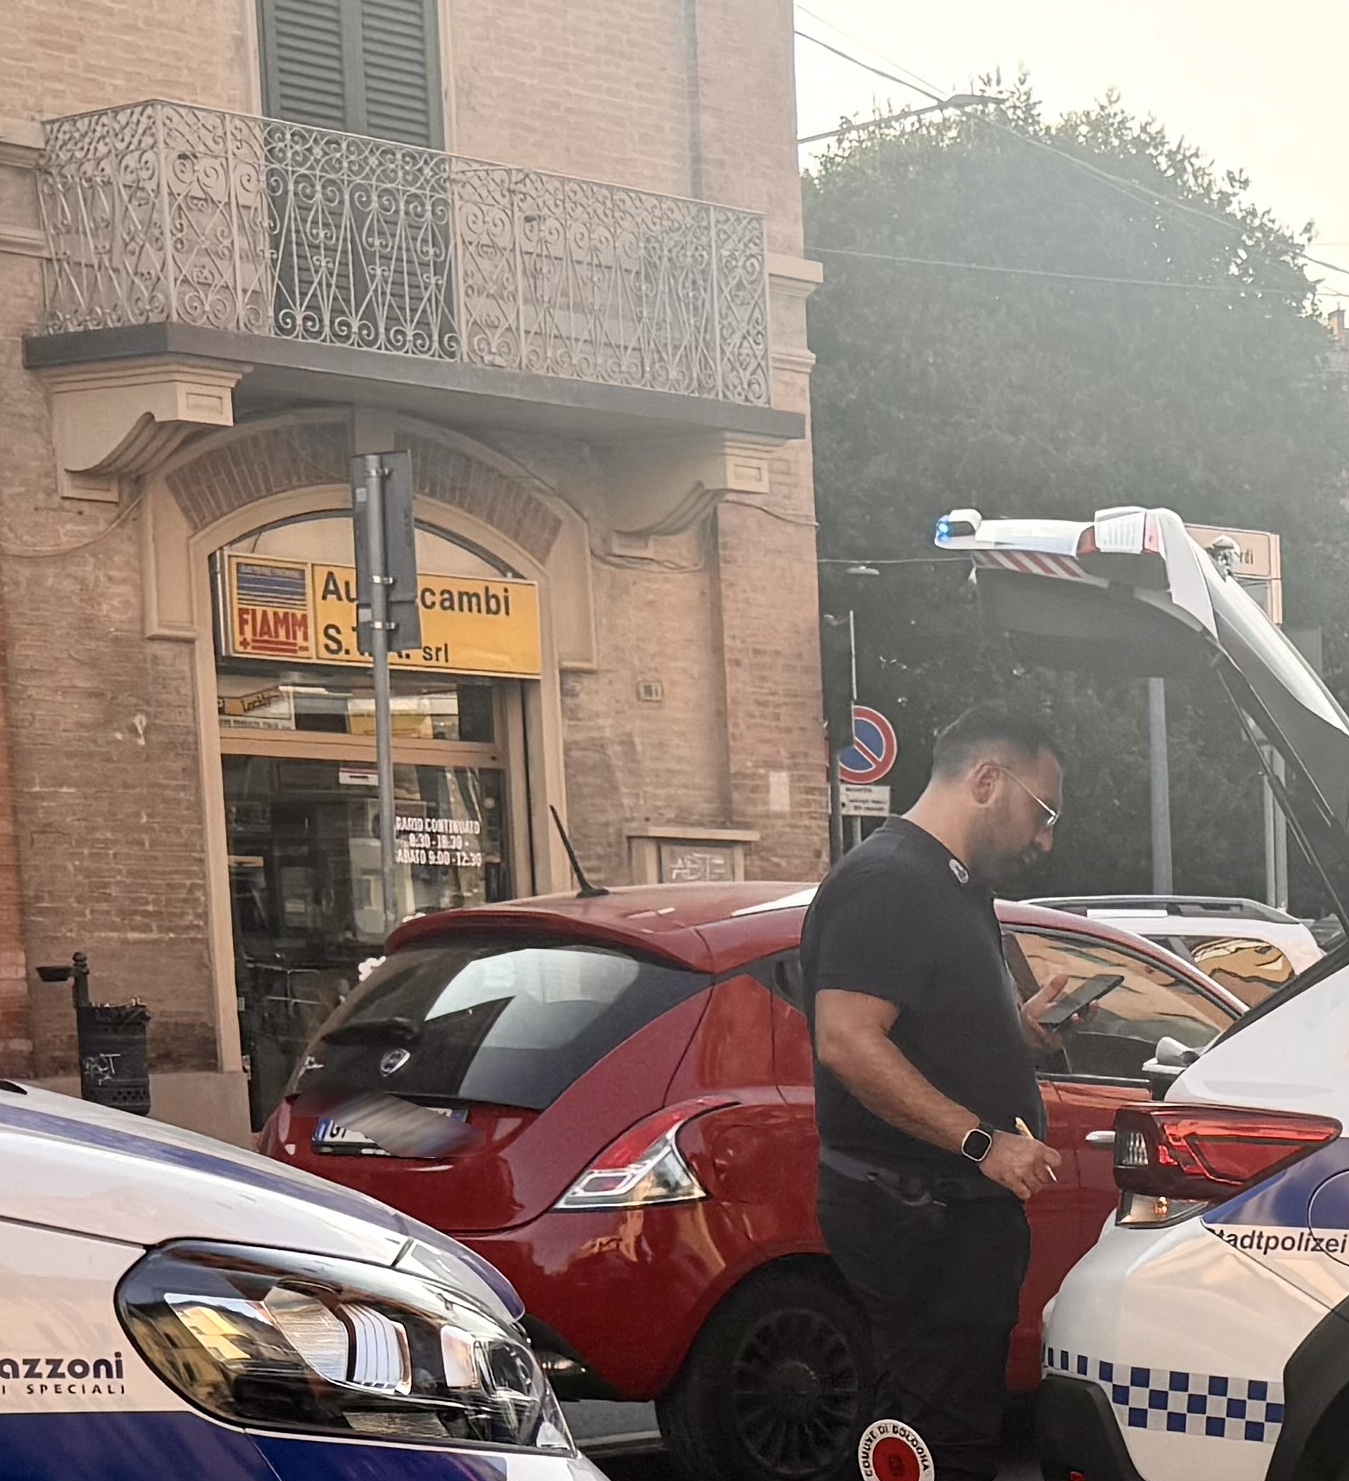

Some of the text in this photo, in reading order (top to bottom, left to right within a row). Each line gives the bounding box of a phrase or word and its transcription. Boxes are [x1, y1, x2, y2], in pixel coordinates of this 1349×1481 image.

[321, 571, 510, 616] Aucambi
[238, 607, 309, 641] FIAMM
[422, 642, 450, 662] srl
[395, 816, 480, 834] RARIO CONTINUATO
[395, 849, 426, 864] ABATO
[26, 1383, 126, 1395] SPECIALI
[877, 1424, 889, 1434] DI
[892, 1424, 929, 1471] BOLOGNA
